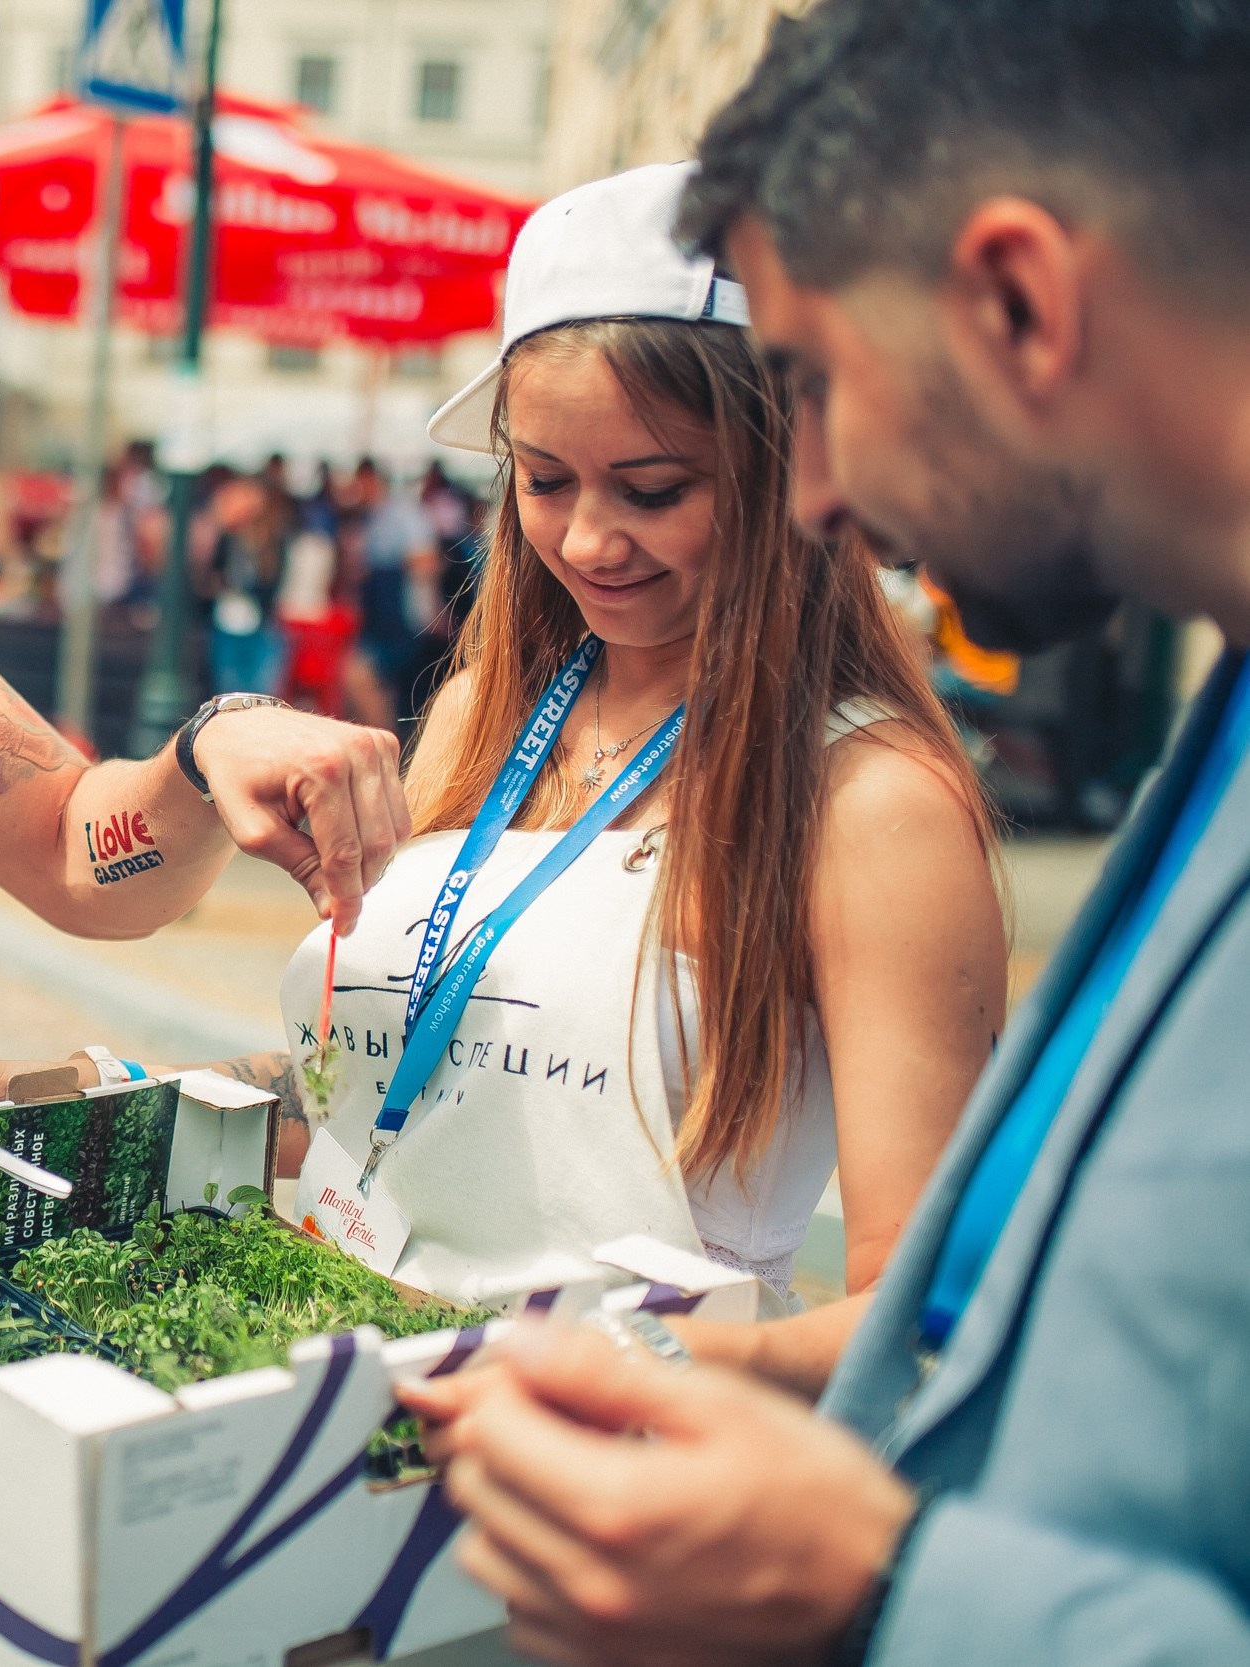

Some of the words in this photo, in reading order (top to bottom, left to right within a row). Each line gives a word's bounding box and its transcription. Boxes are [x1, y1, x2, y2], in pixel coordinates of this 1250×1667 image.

[514, 638, 599, 771] GASTREET
[85, 822, 97, 863] I
[95, 810, 155, 862] LOVE
[94, 849, 165, 886] GASTREET
[408, 869, 468, 1021] GASTREET
[429, 927, 495, 1034] #gastreetshow
[449, 1039, 608, 1096] СПЕЦИИ
[6, 1129, 26, 1221] РАЗЛНЫХ
[23, 1132, 45, 1238] СОБСТНОЕ
[318, 1186, 365, 1220] Martini
[346, 1218, 377, 1247] Tonic
